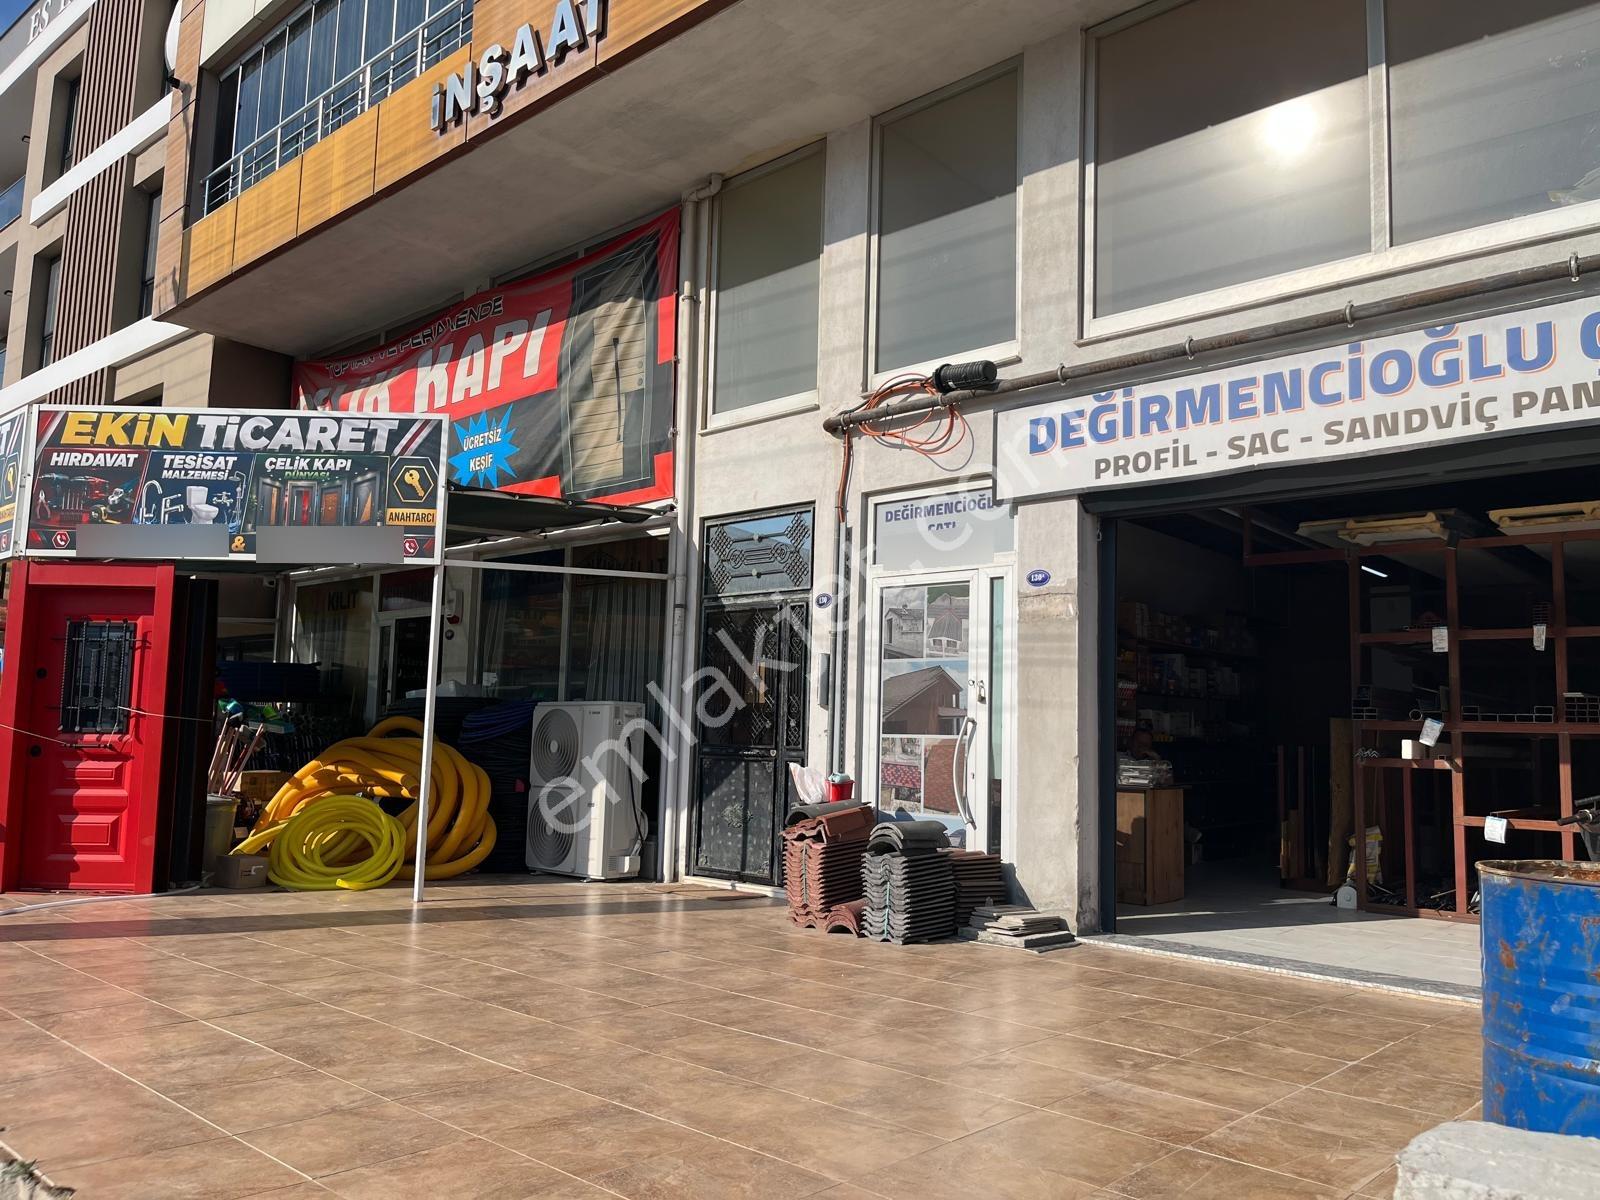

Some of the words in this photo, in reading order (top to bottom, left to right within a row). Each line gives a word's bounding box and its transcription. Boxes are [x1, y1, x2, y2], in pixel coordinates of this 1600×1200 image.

[414, 309, 553, 413] KAPI
[1028, 320, 1557, 456] DEĞİRMENCİOĞLU
[463, 426, 502, 451] ÜCRETSİZ
[1094, 438, 1198, 479] PROFİL
[1228, 426, 1290, 460] SAC
[1324, 391, 1498, 444] SANDVİÇ
[50, 452, 138, 468] HIRDAVAT
[163, 454, 237, 470] TESİSAT
[264, 456, 310, 471] ÇELİK
[313, 459, 351, 471] KAPI
[469, 452, 493, 472] KEŞİF
[161, 469, 229, 481] MALZEMESİ
[284, 471, 330, 481] DÜNYASI
[388, 511, 435, 524] ANAHTARCI
[231, 535, 245, 551] &
